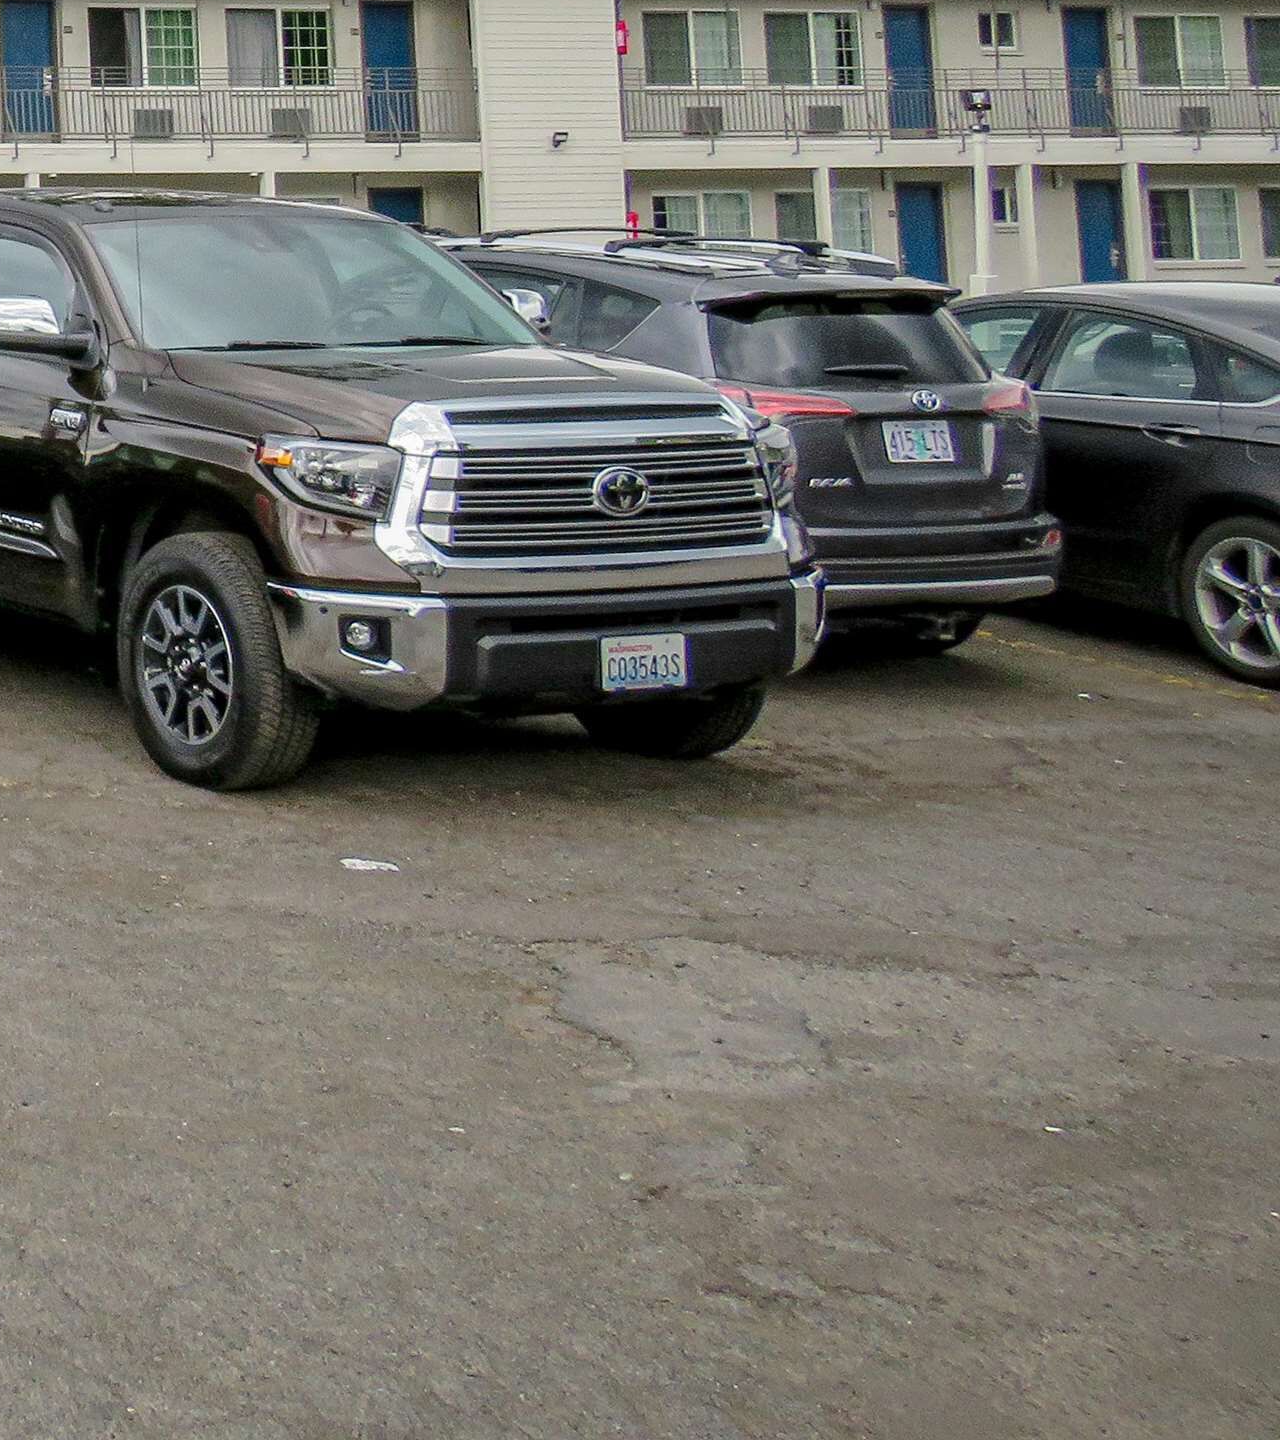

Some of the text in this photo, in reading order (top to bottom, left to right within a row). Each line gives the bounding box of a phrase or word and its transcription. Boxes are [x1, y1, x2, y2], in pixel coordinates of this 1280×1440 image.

[890, 429, 949, 456] 415 LTS
[607, 653, 681, 682] C03543S
